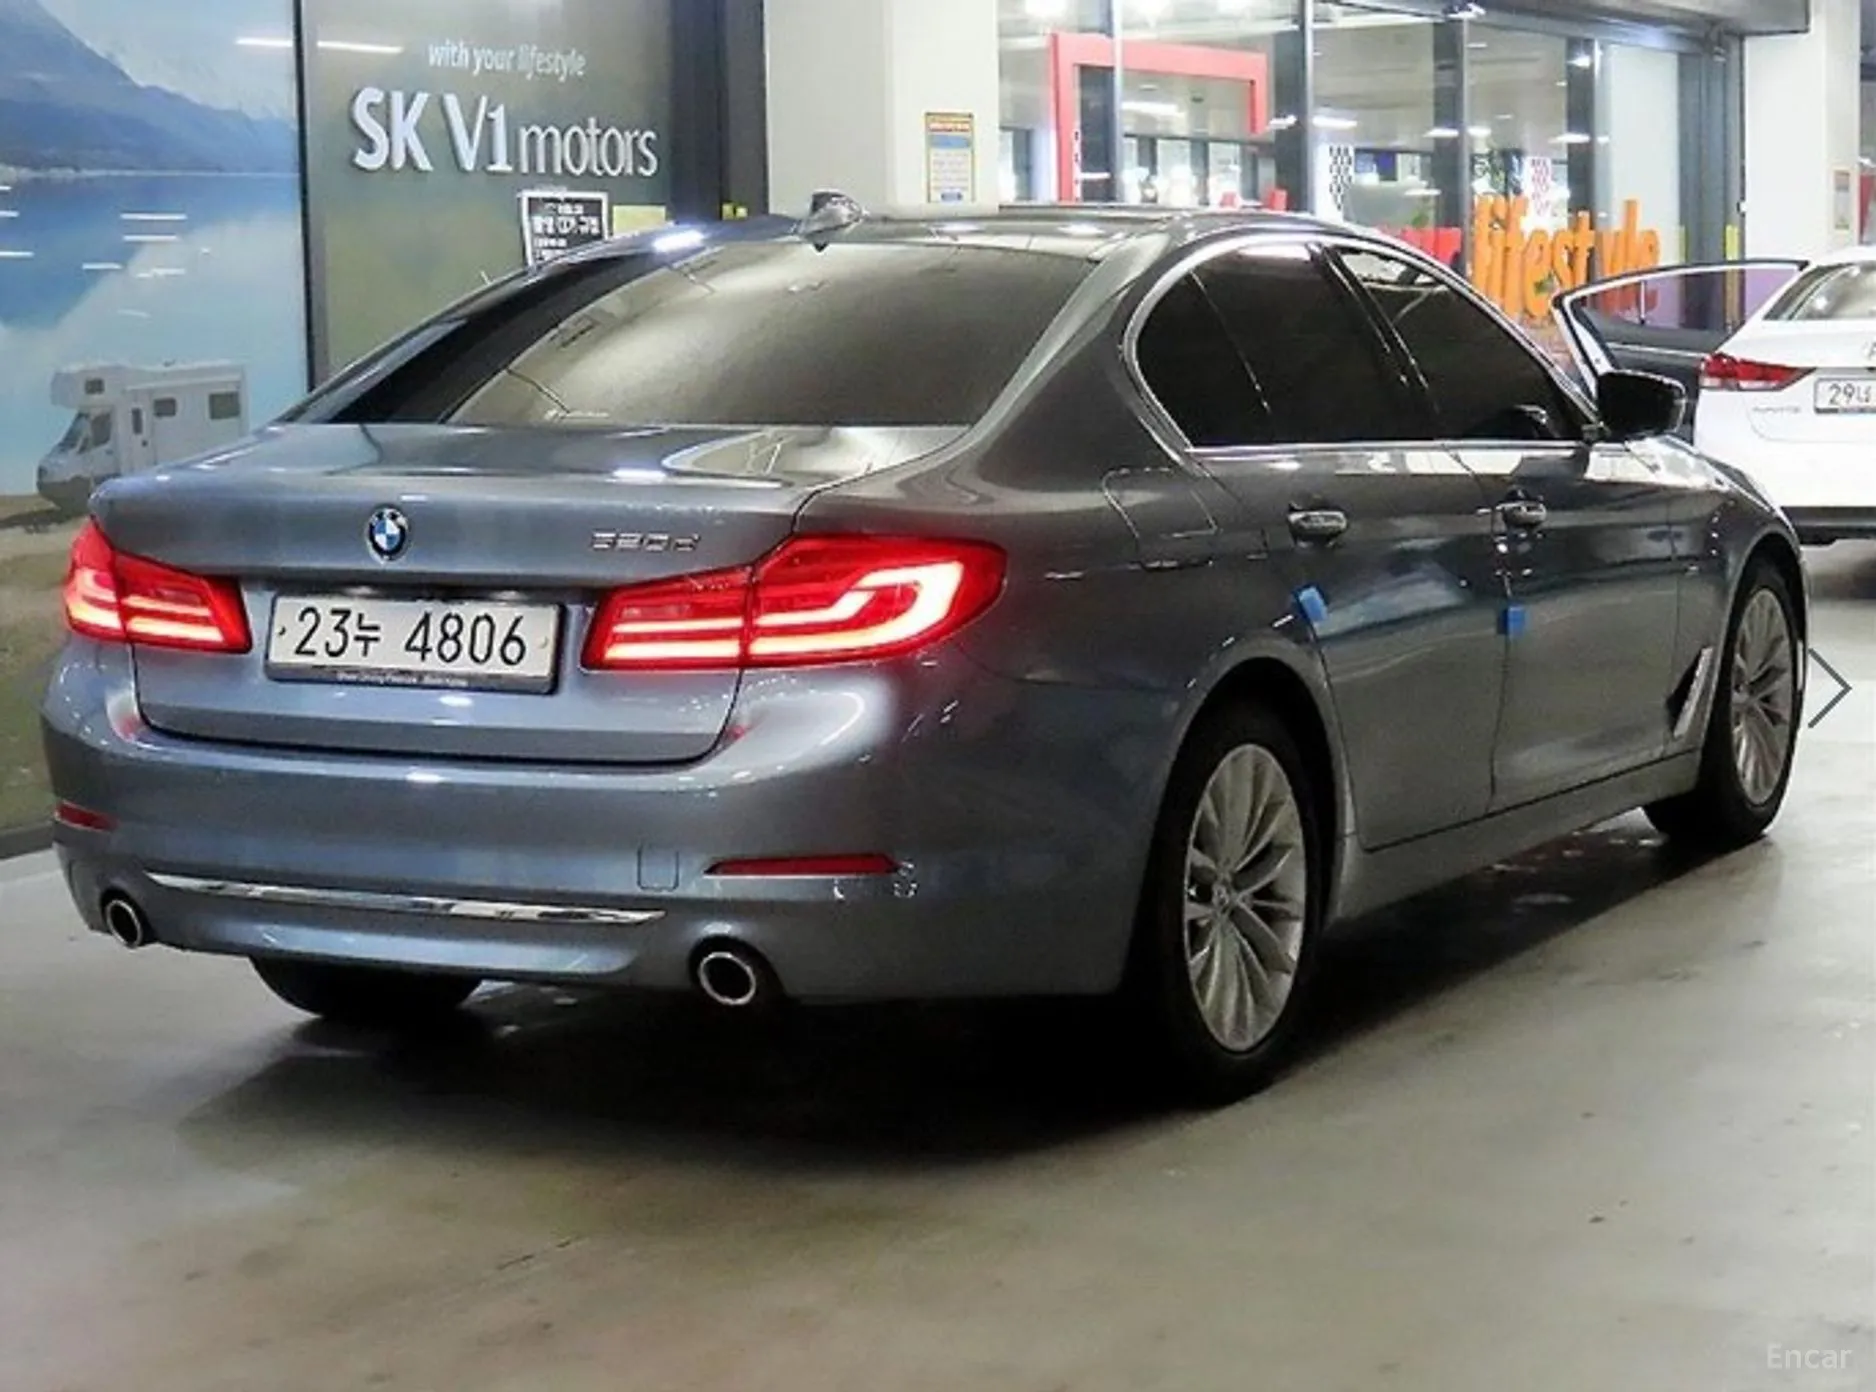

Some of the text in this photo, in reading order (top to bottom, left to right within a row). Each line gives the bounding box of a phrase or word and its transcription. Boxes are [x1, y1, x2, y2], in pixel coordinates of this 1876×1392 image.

[428, 38, 588, 82] with your lifestyle
[351, 86, 658, 177] SK V1 motors
[590, 530, 702, 553] 520d
[294, 606, 527, 667] 23누 4806
